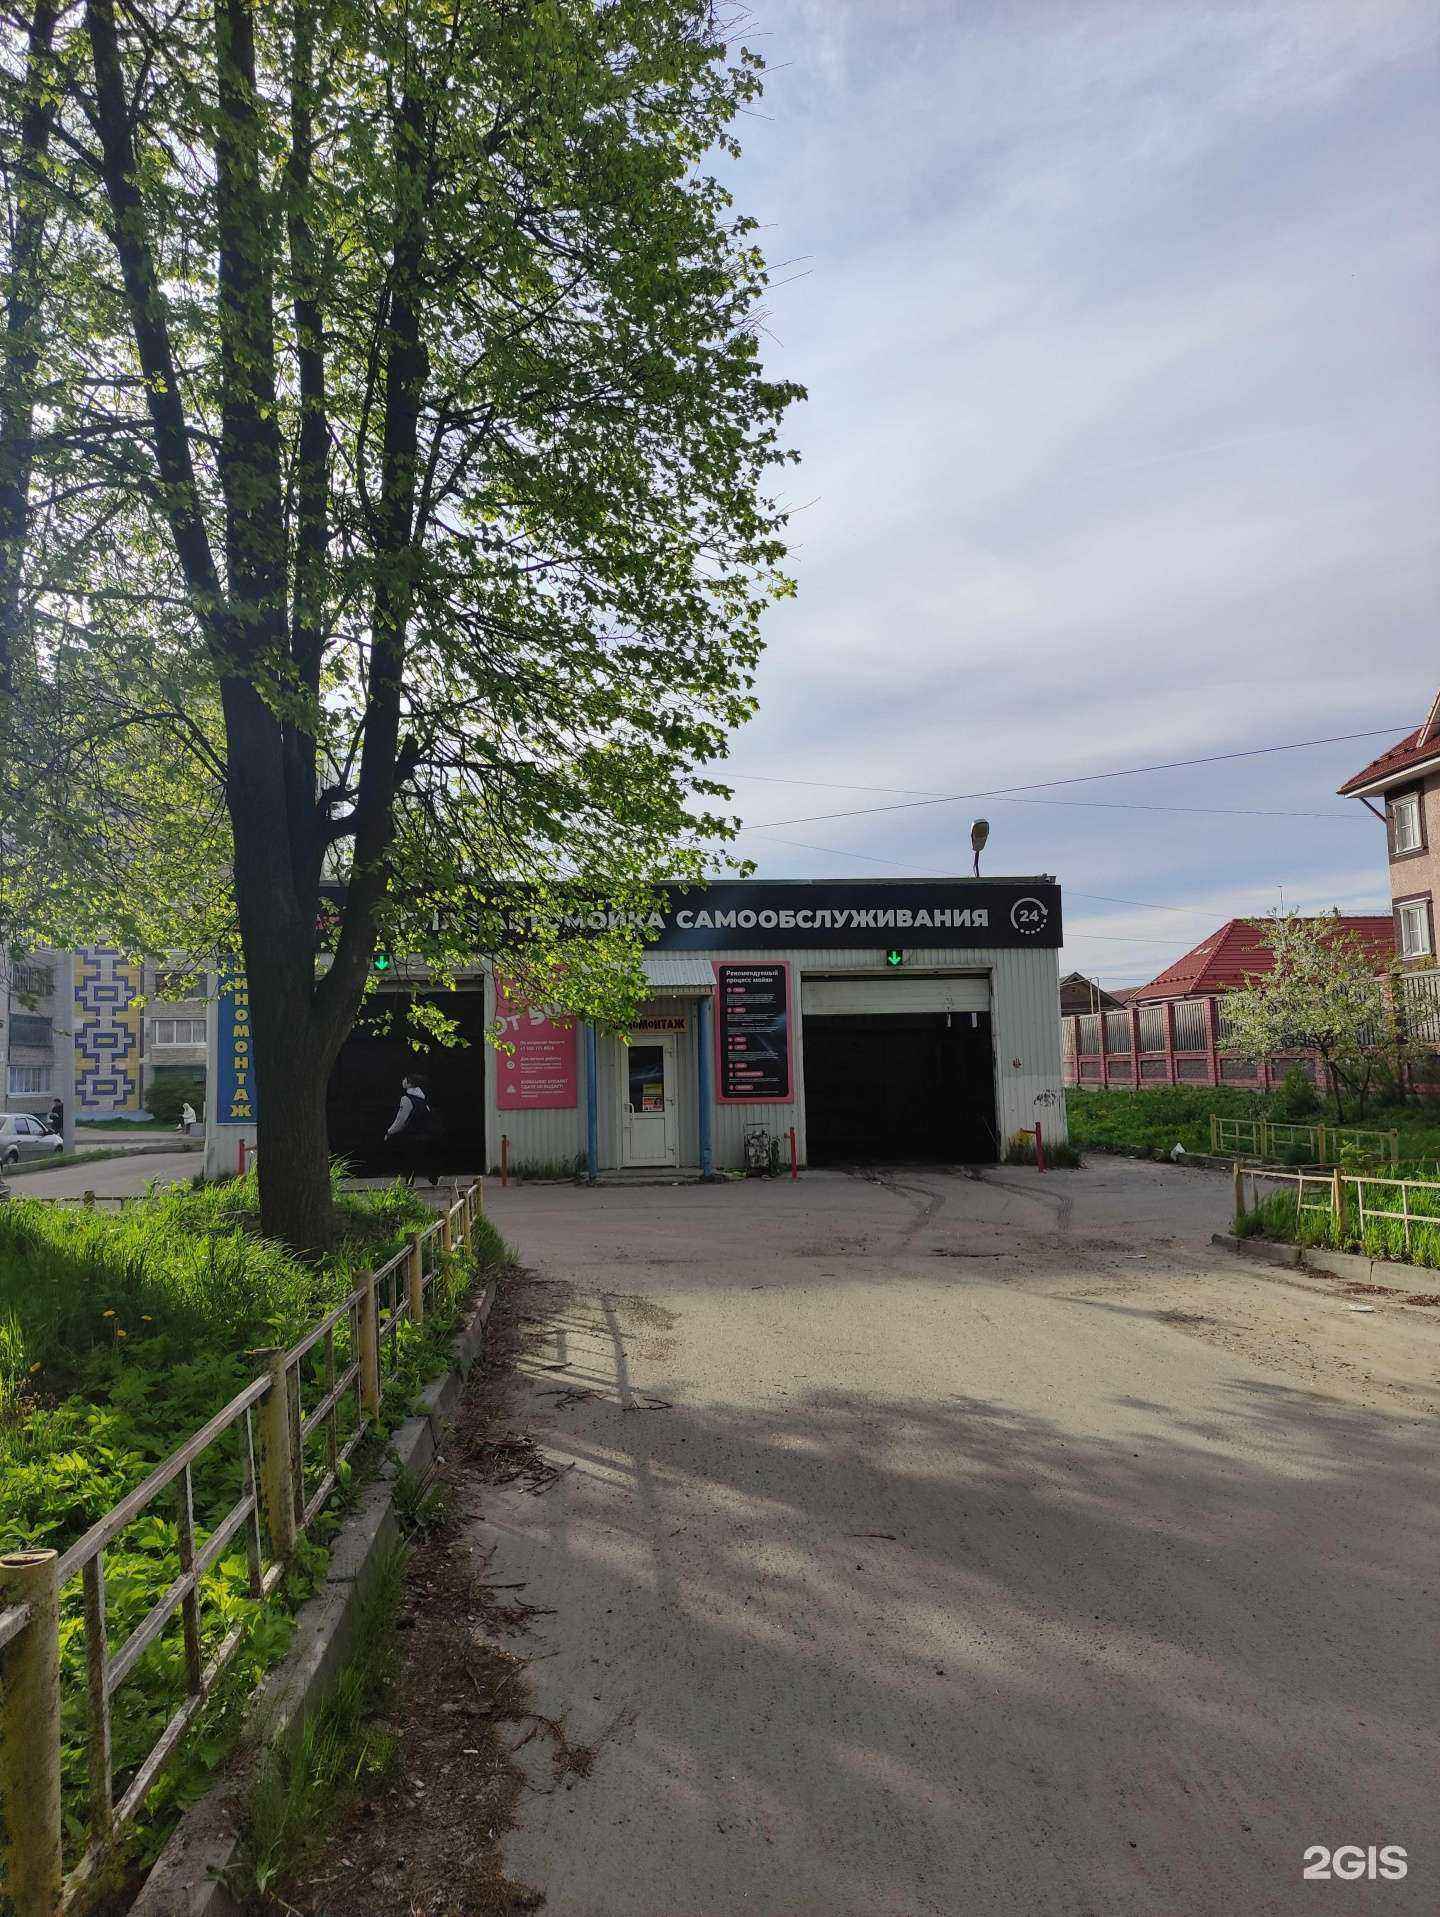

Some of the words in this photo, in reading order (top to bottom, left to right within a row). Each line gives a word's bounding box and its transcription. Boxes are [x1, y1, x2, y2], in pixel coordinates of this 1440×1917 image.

[675, 908, 989, 930] САМООБСЛУЖИВАНИЯ
[1019, 909, 1040, 922] 24
[612, 1018, 686, 1030] ОМОНТАЖ
